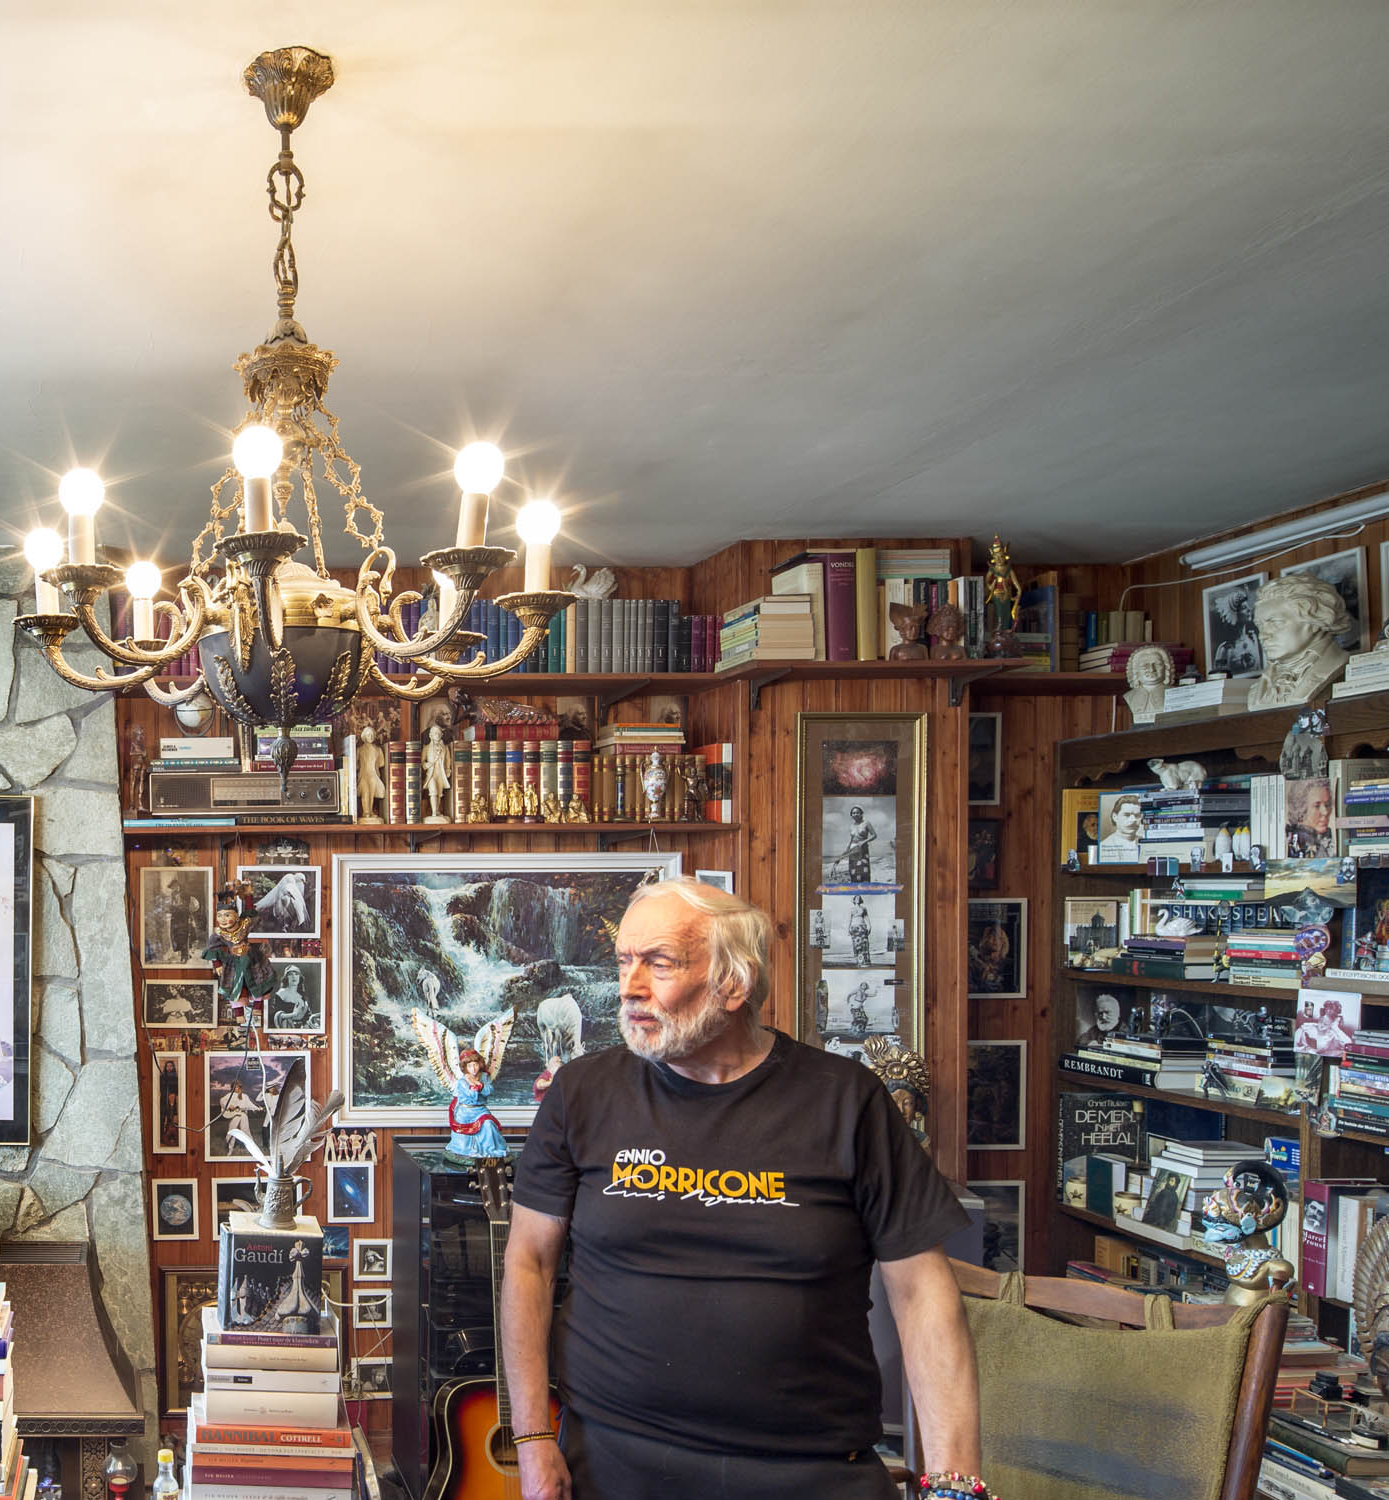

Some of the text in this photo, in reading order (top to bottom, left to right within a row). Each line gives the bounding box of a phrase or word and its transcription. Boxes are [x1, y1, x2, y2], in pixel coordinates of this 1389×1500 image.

[1064, 1059, 1124, 1079] REMBRANDT
[1075, 1110, 1096, 1123] DE
[1082, 1133, 1135, 1145] HEELAL
[615, 1149, 666, 1165] ENNIO
[612, 1162, 786, 1198] MORRICONE
[234, 1248, 284, 1264] Gaudí
[201, 1430, 322, 1443] HANNIBAL COTTRELL
